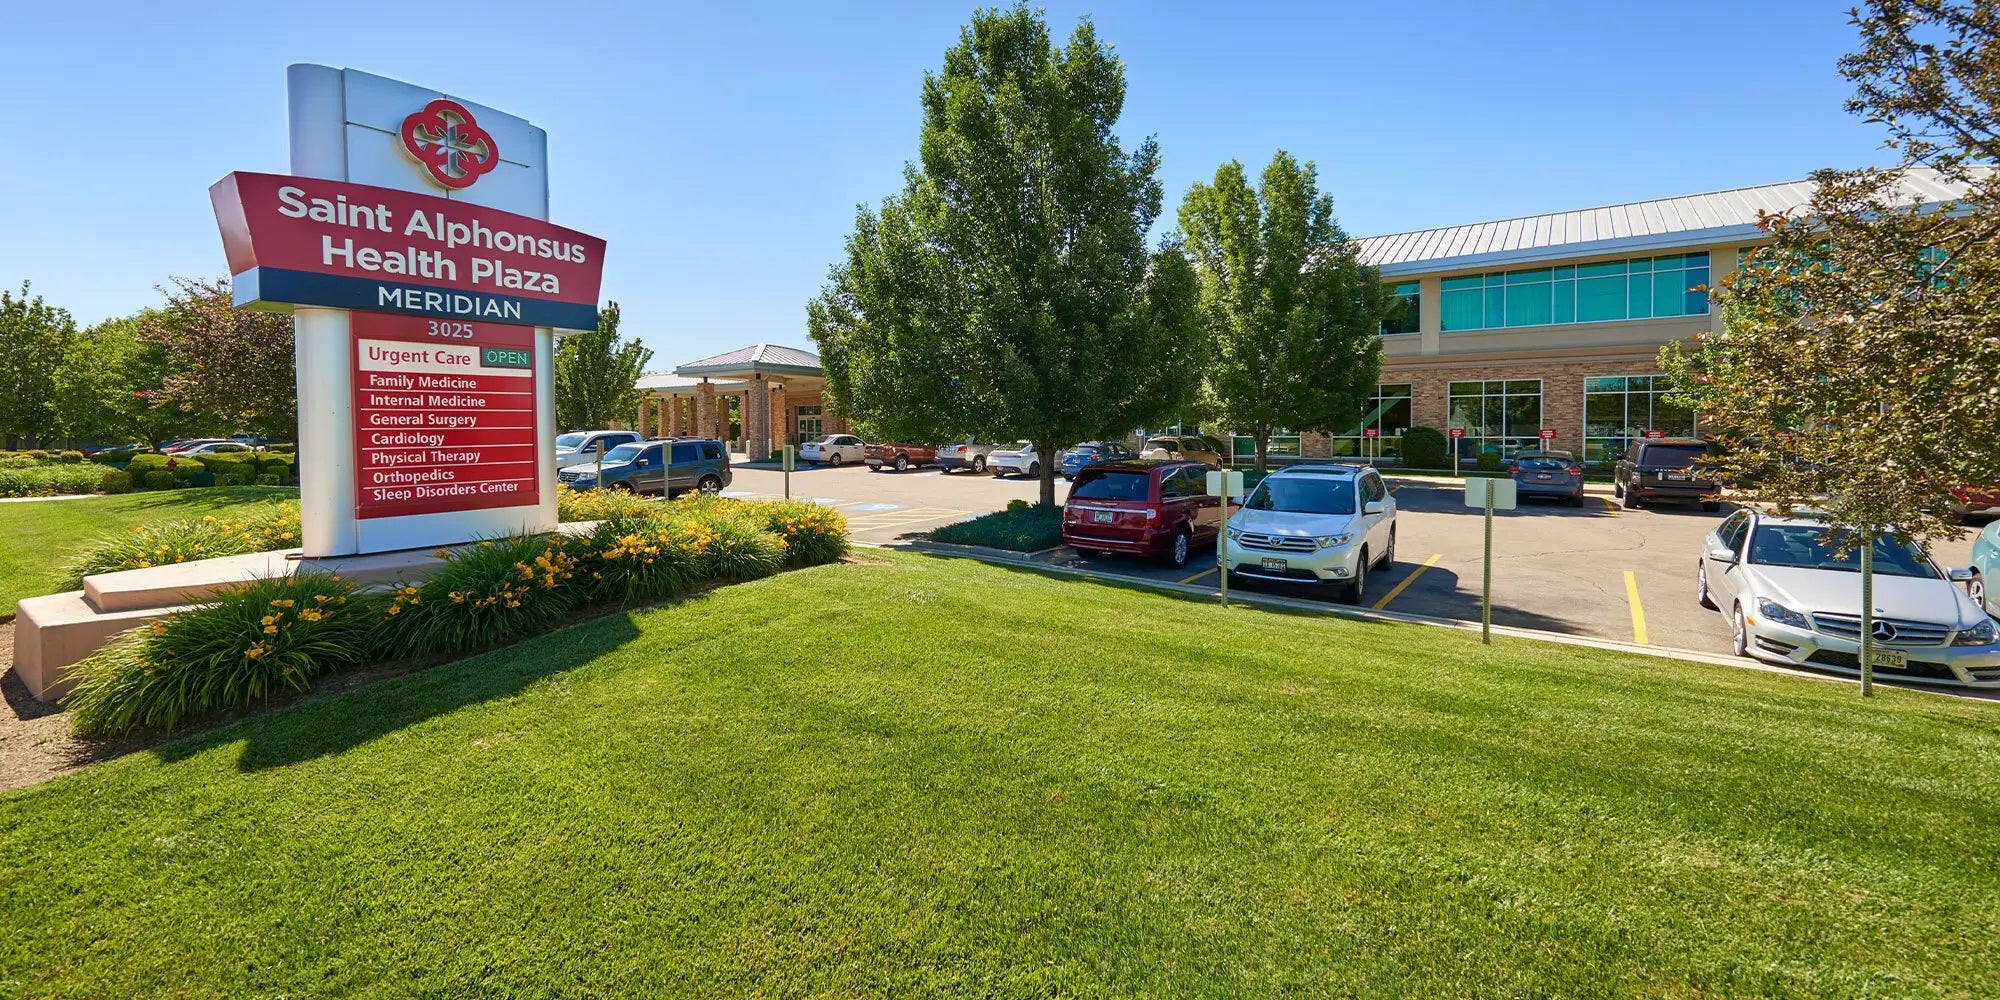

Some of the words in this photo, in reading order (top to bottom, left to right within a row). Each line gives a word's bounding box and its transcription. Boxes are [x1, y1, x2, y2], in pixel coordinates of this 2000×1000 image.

[278, 186, 392, 233] Saint
[404, 209, 586, 264] Alphonsus
[322, 235, 456, 281] Health
[471, 257, 560, 294] Plaza
[378, 286, 521, 320] MERIDIAN
[428, 320, 474, 339] 3025
[368, 346, 429, 365] Urgent
[434, 350, 471, 366] Care
[486, 350, 527, 365] OPEN
[369, 374, 414, 390] Family
[418, 376, 477, 389] Medicine
[370, 394, 424, 406] Internal
[428, 395, 486, 407] Medicine
[370, 413, 424, 425] General
[428, 413, 477, 428] Surgery
[371, 432, 445, 446] Cardiology
[371, 451, 426, 467] Physical
[430, 450, 481, 463] Therapy
[373, 469, 455, 484] Orthopedics
[373, 488, 412, 501] Sleep
[416, 484, 477, 498] Disorders
[480, 481, 519, 493] Center
